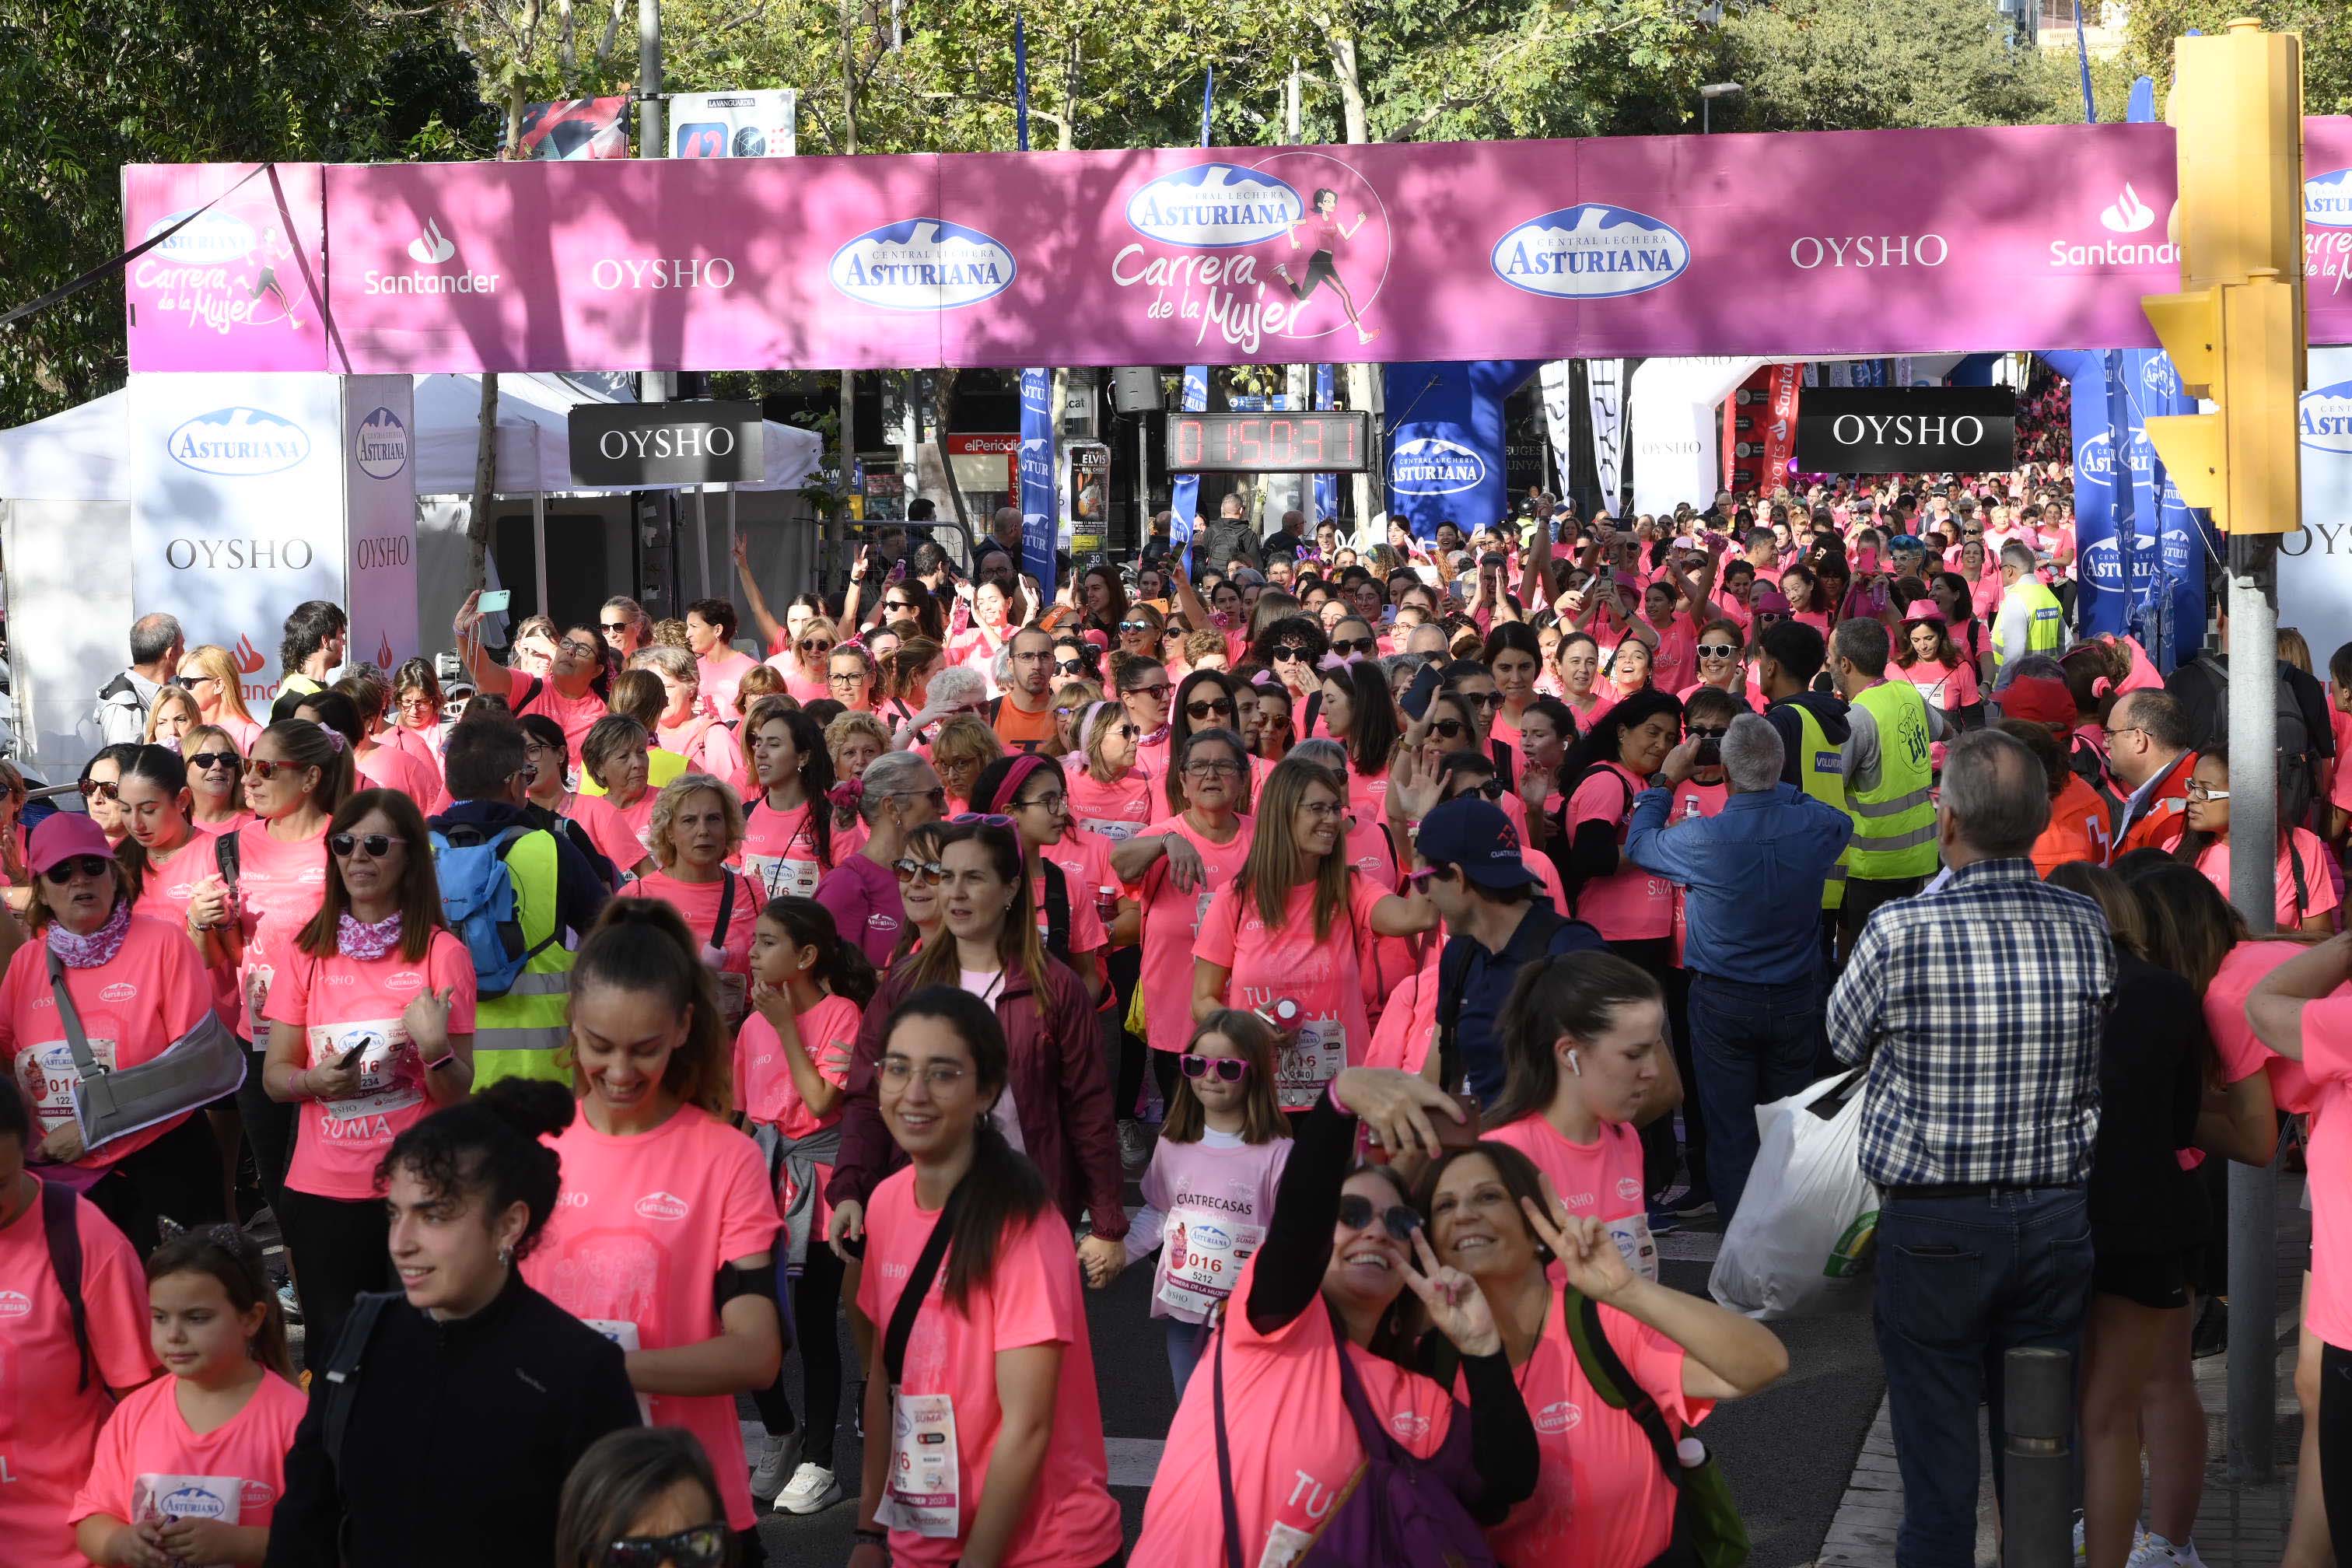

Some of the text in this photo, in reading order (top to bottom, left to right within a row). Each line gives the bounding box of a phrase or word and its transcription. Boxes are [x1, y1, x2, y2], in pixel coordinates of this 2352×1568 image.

[1139, 195, 1289, 227] ASTURIANA
[1536, 234, 1668, 247] CENTRAL LECHERA
[1790, 233, 1948, 268] OYSHO
[2049, 239, 2181, 267] Santand
[871, 249, 933, 260] CENTRAL
[1111, 243, 1256, 287] Carrera
[1506, 240, 1675, 275] ASTURIANA
[2322, 254, 2337, 276] la
[135, 259, 227, 289] Carrera
[364, 269, 500, 295] Santander
[591, 257, 735, 291] OYSHO
[844, 257, 1002, 287] ASTURIANA
[158, 288, 261, 334] de la Mujer
[1147, 281, 1311, 355] de la Mujer
[600, 427, 734, 460] OYSHO
[1833, 414, 1983, 446] OYSHO
[179, 432, 299, 459] ASTURIANA
[359, 434, 404, 461] ASTURIANA
[1082, 454, 1106, 464] ELVIS
[1390, 465, 1478, 482] ASTURIANA
[166, 537, 313, 569] OYSHO
[357, 535, 409, 569] OYSHO
[1090, 555, 1101, 563] 30
[1244, 986, 1271, 1006] TU
[360, 1078, 380, 1087] 234
[320, 1115, 392, 1139] SUMA
[1188, 1253, 1222, 1272] 016
[1192, 1271, 1213, 1284] 5212
[914, 1412, 943, 1423] SUMA
[166, 1499, 219, 1514] ASTURIANA
[929, 1496, 948, 1505] 2023
[1288, 1469, 1335, 1518] TU
